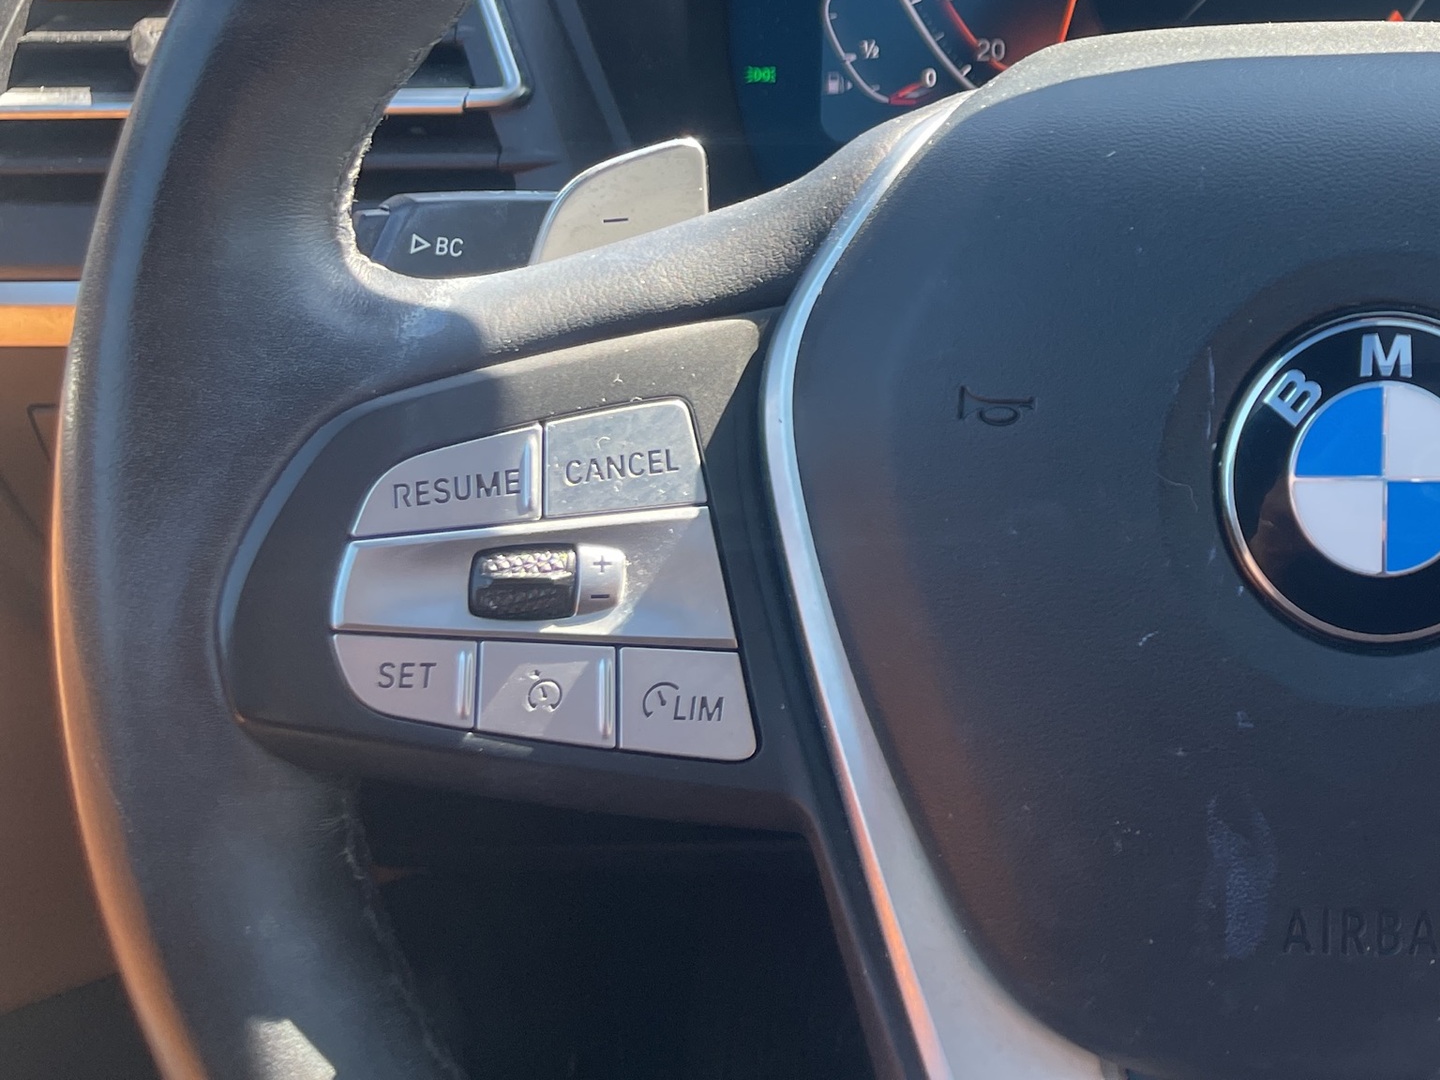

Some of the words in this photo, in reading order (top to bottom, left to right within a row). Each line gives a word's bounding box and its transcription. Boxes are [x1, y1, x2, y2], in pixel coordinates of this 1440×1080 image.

[976, 37, 1007, 62] 20
[921, 67, 938, 89] 0
[436, 236, 464, 258] BC
[564, 448, 680, 488] CANCEL
[392, 468, 522, 509] RESUME
[377, 661, 438, 690] SET
[673, 695, 725, 722] LIM
